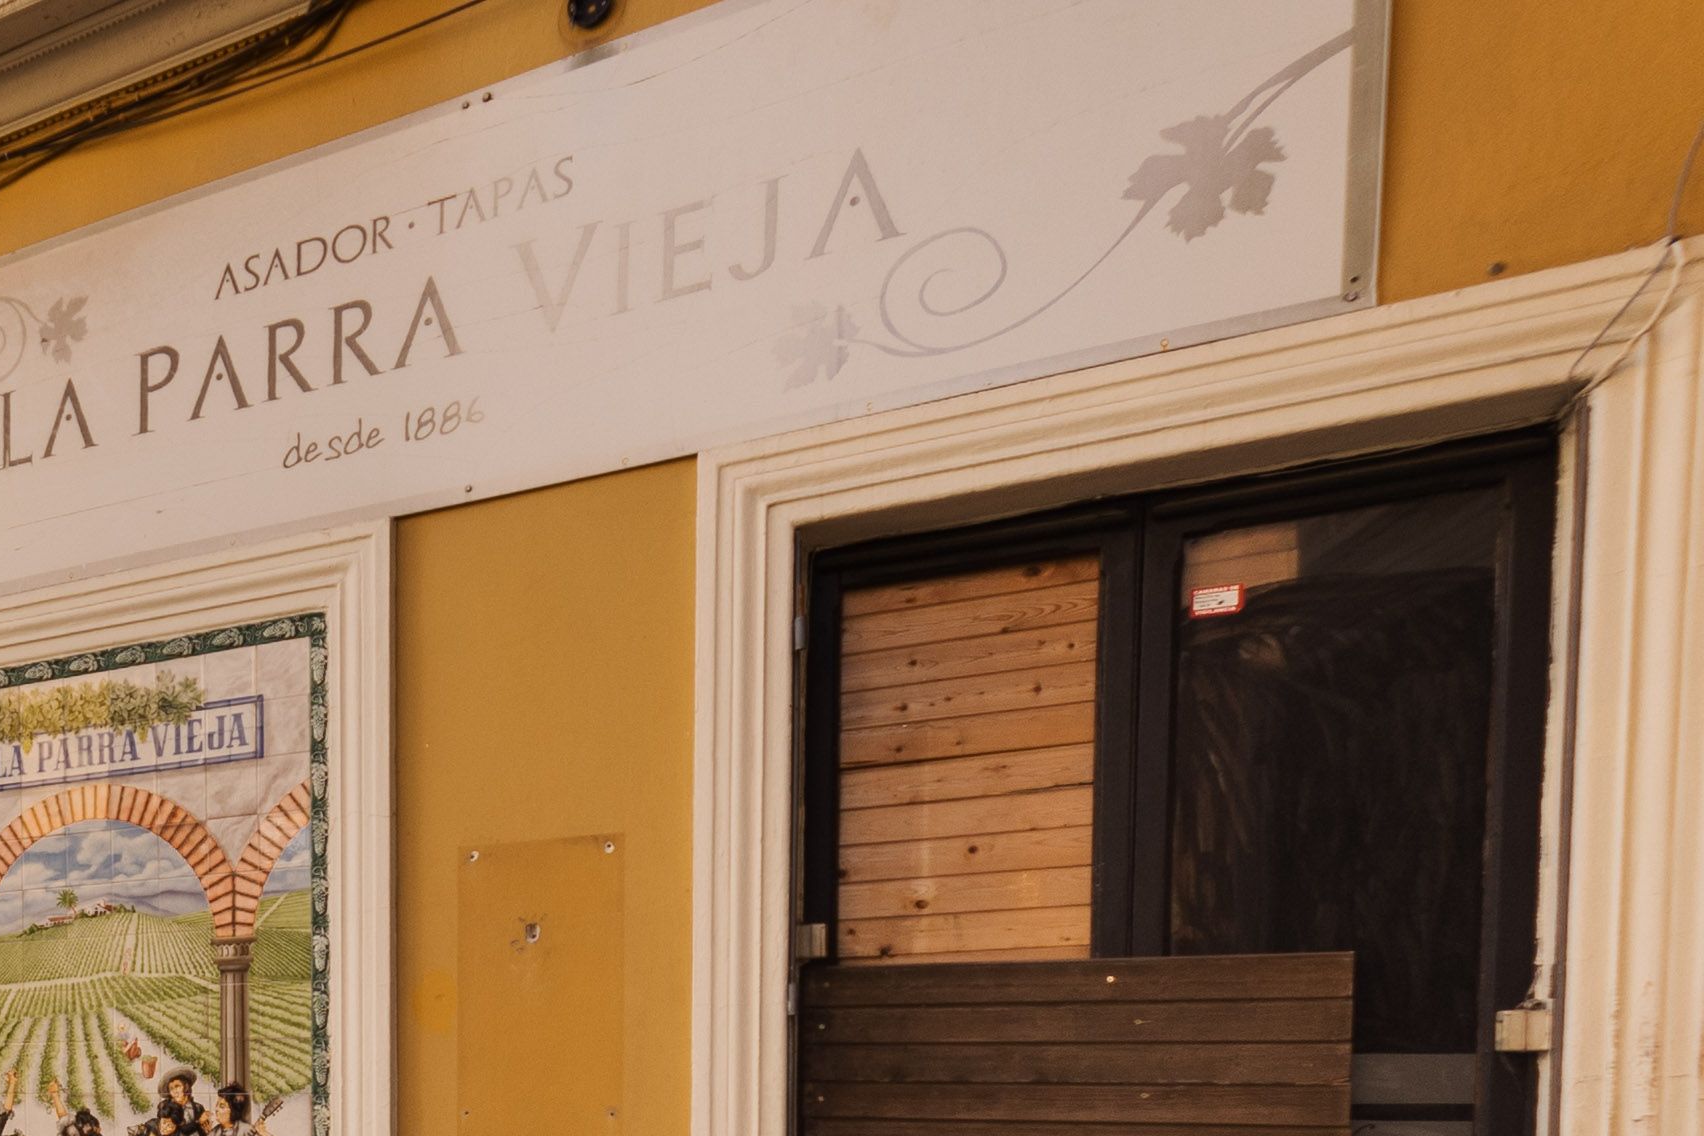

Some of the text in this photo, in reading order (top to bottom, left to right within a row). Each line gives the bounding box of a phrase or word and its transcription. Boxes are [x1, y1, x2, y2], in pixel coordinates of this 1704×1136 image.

[215, 155, 576, 300] ASADOR TAPAS
[133, 276, 464, 436] PARRA
[515, 146, 906, 332] VIEJA
[283, 395, 486, 469] desde 1886
[37, 728, 141, 774] PARRA
[152, 711, 250, 757] VIEJA
